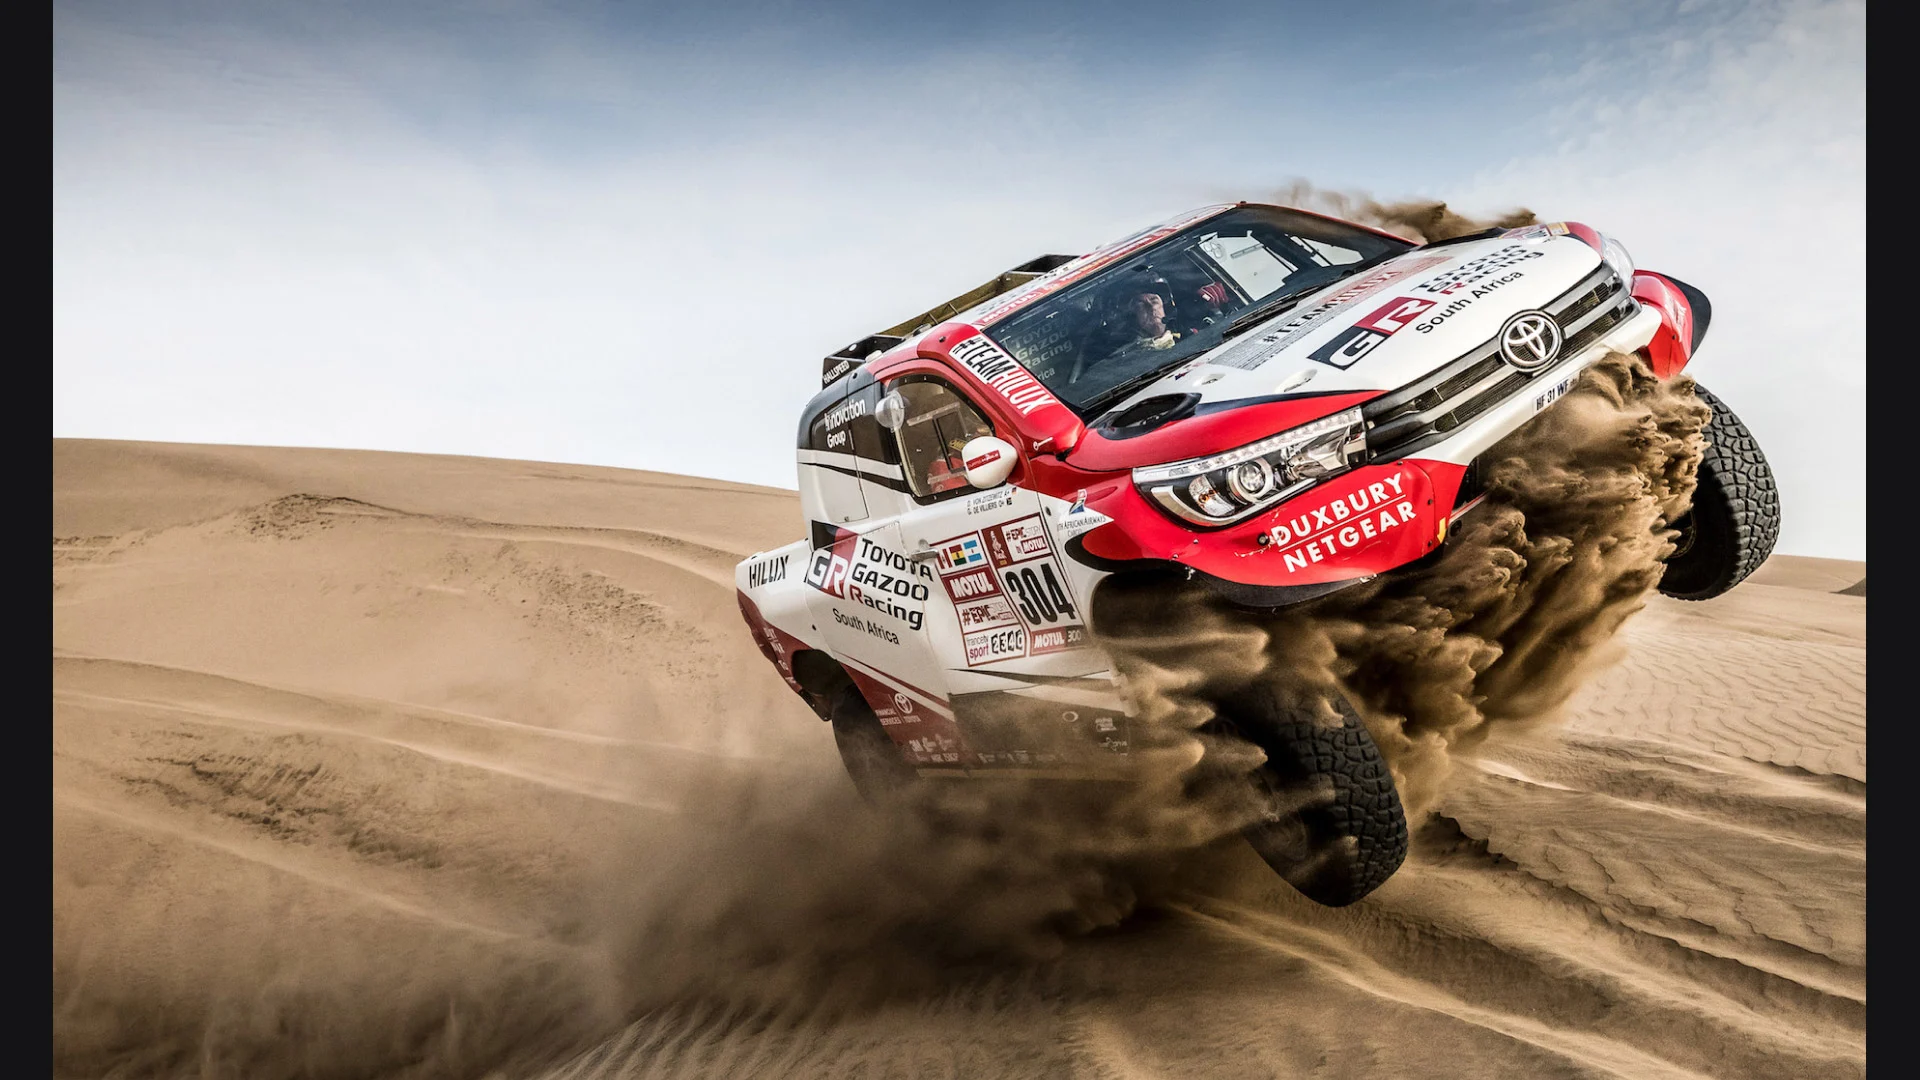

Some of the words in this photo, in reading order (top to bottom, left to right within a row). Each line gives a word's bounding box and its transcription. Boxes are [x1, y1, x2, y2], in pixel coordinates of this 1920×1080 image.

[1410, 245, 1522, 291] TOYOTA
[1427, 250, 1527, 292] GAZOO
[1439, 252, 1544, 295] Racing
[1415, 298, 1472, 334] South
[1471, 271, 1524, 299] Africa
[1329, 299, 1435, 367] GR
[823, 360, 850, 384] HALLSPEED
[1547, 388, 1556, 404] 31
[827, 430, 847, 449] Group
[1271, 472, 1403, 547] DUXBURY
[1023, 537, 1046, 552] MOTUL
[1283, 501, 1417, 573] NETGEAR
[808, 547, 849, 597] GR
[862, 538, 934, 582] TOYOTA
[852, 562, 929, 601] GAZOO
[950, 572, 994, 599] MOTUL
[1005, 563, 1076, 625] 304
[832, 607, 865, 633] South
[867, 620, 901, 646] Africa
[849, 584, 924, 631] Racing
[970, 645, 989, 660] sport
[1034, 631, 1065, 649] MOTUL
